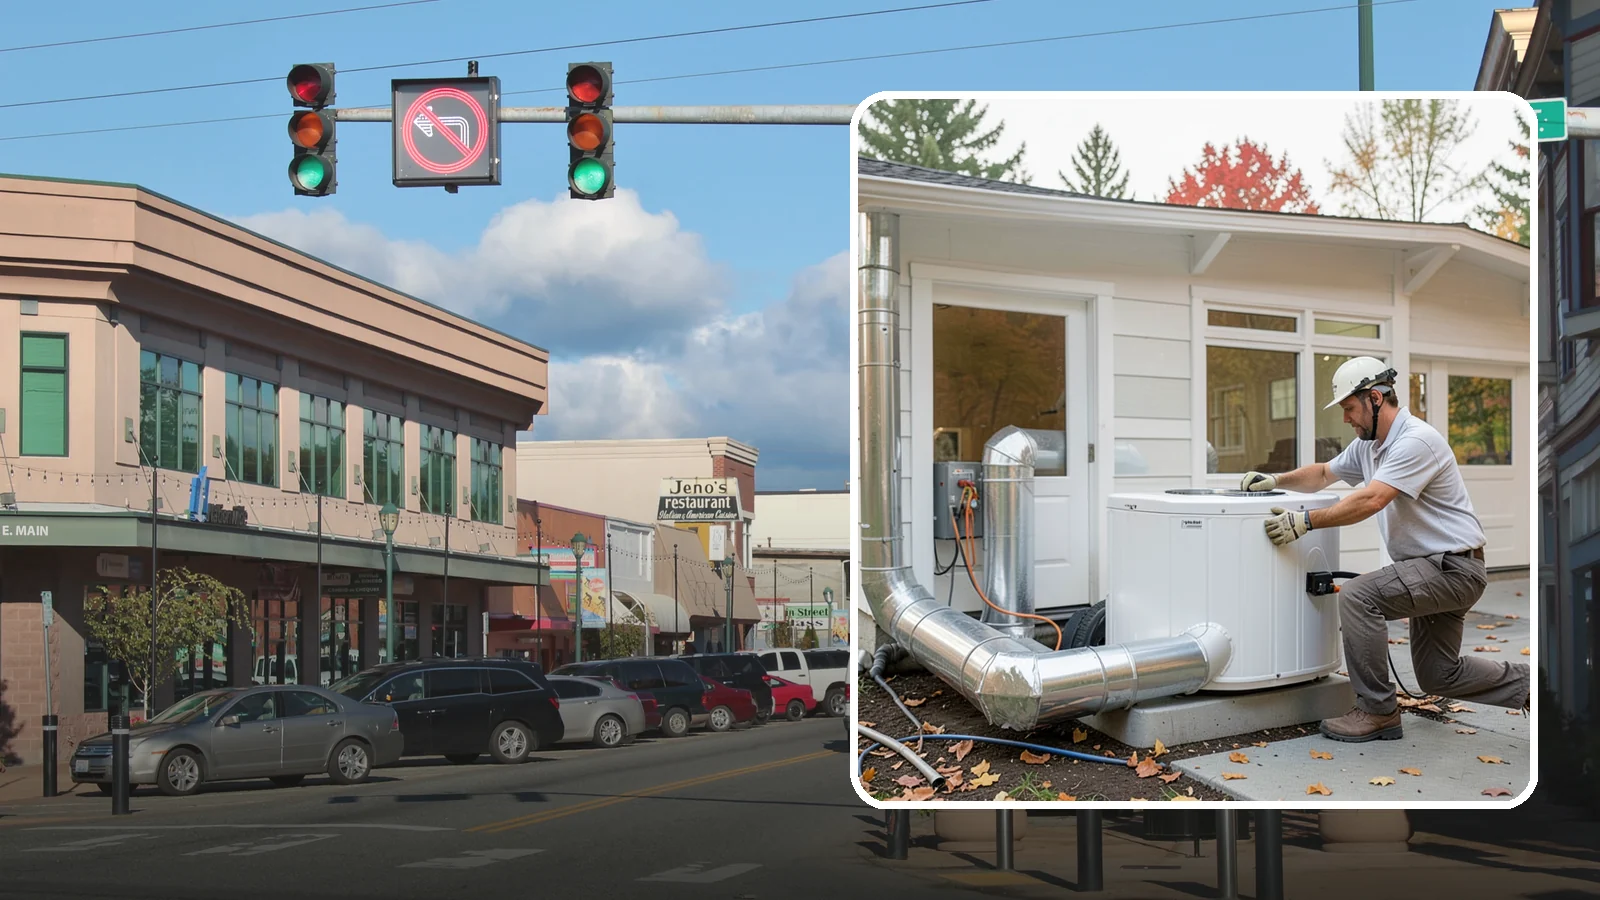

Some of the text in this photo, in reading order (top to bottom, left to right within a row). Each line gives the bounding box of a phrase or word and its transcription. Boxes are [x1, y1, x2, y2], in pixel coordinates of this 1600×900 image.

[670, 480, 727, 494] Jeno's
[665, 496, 731, 509] restaurant
[658, 510, 681, 519] Italian
[686, 510, 714, 519] American
[715, 510, 737, 519] Cuisine
[2, 525, 49, 536] E. MAIN
[797, 608, 828, 617] Street
